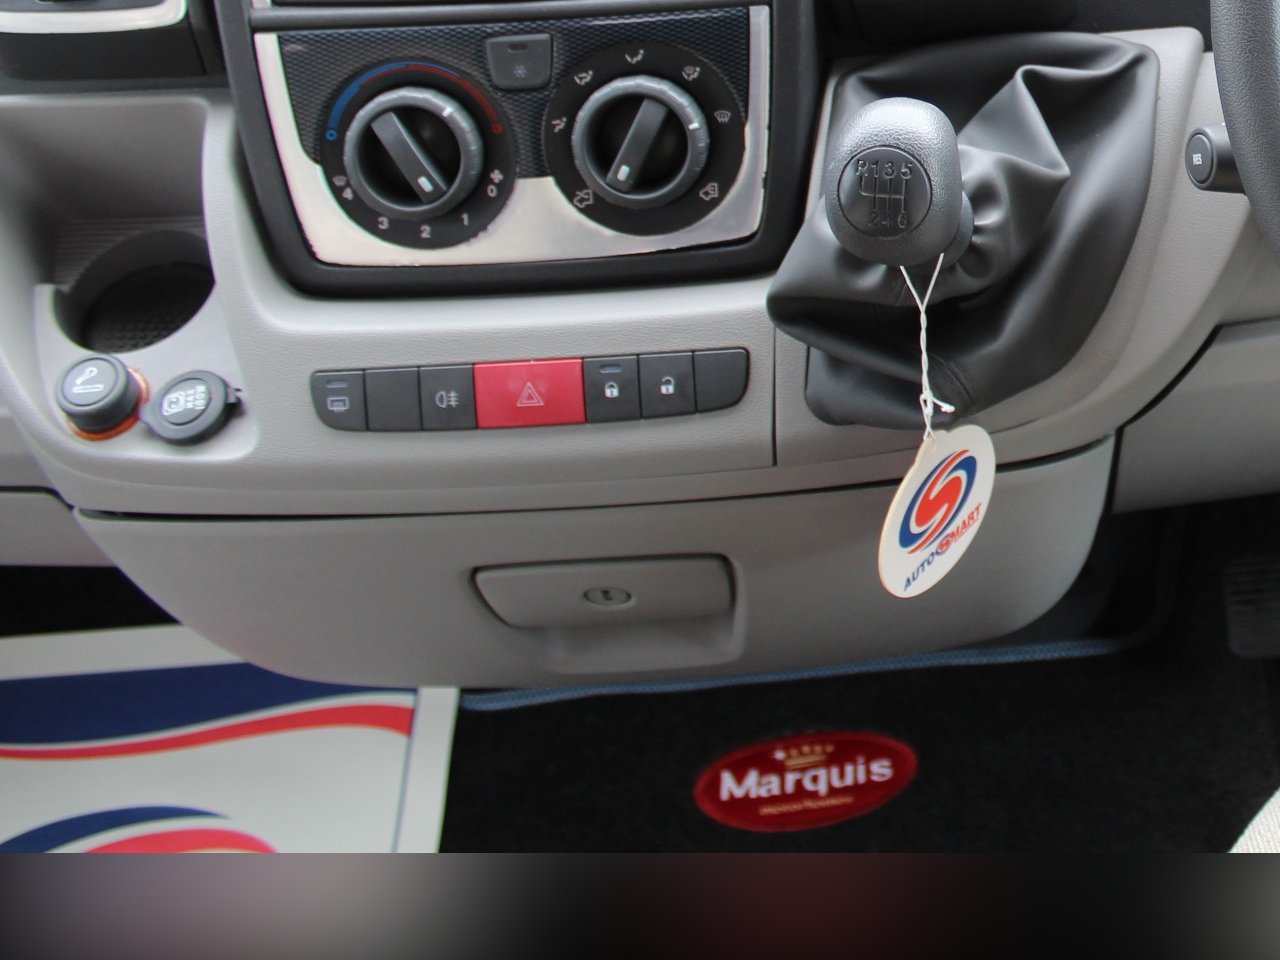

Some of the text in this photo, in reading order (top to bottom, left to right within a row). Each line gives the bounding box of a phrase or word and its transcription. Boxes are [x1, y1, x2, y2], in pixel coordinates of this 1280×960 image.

[856, 158, 913, 180] R 1 3 5
[341, 186, 353, 200] 4
[487, 184, 497, 198] 0
[378, 216, 389, 230] 3
[461, 213, 469, 227] 1
[868, 211, 880, 227] 2
[897, 212, 910, 229] 6
[420, 225, 431, 239] 2
[719, 756, 893, 798] Marquis
